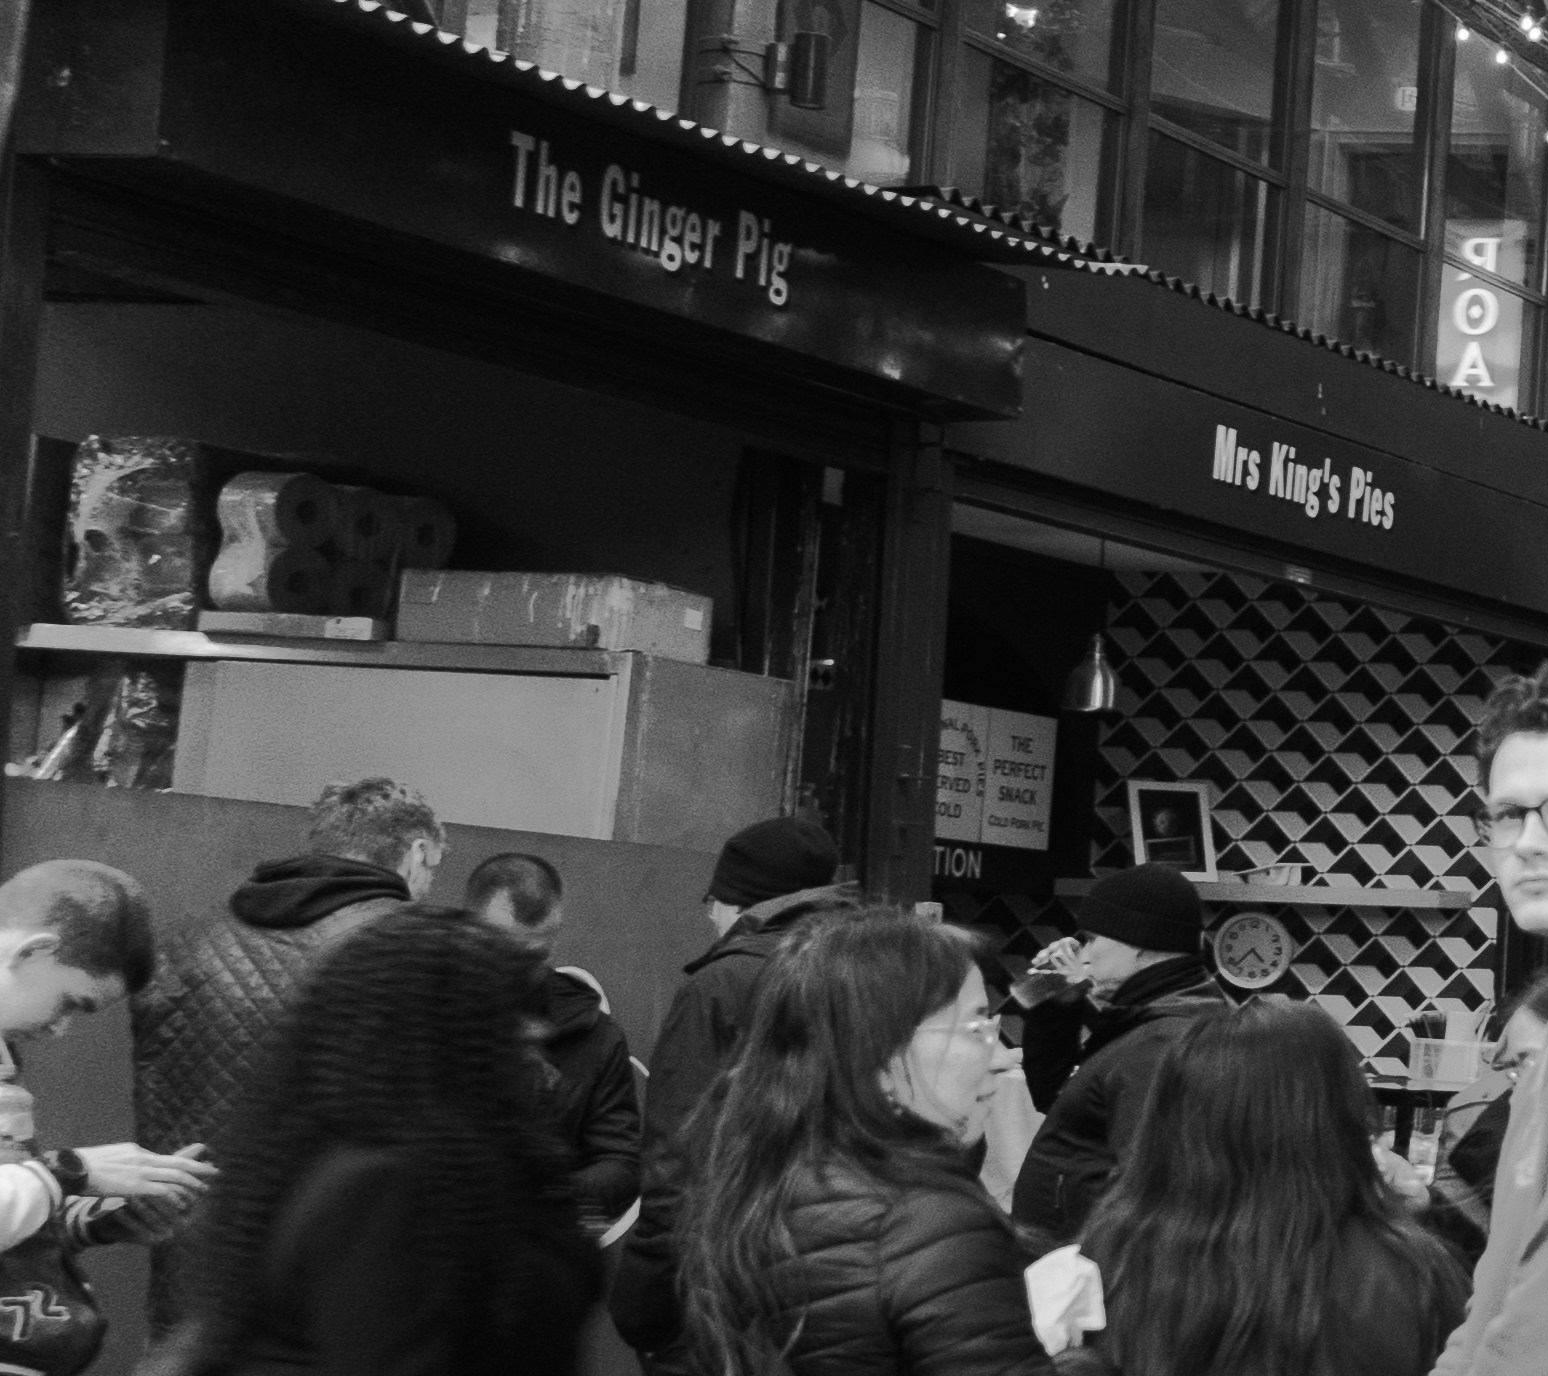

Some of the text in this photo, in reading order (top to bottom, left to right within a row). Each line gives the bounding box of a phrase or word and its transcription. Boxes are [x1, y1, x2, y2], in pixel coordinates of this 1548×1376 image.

[510, 129, 792, 306] The Ginger Pig
[1213, 424, 1395, 529] Mrs King's Pies
[1011, 734, 1033, 754] THE
[993, 758, 1047, 781] PERFECT
[998, 784, 1038, 806] SNACK
